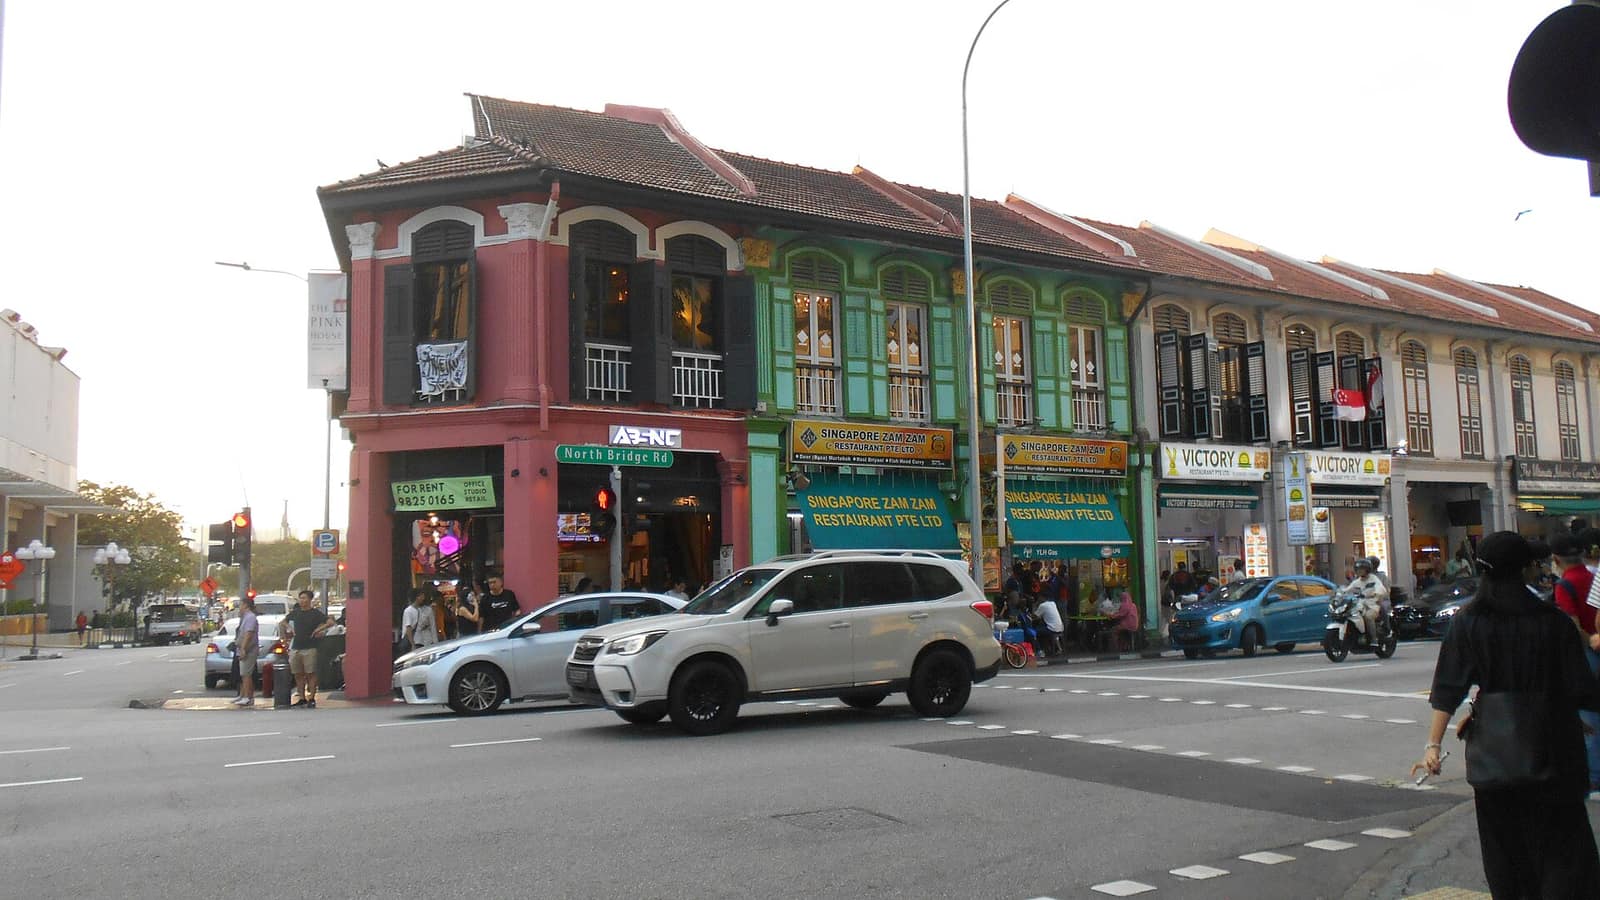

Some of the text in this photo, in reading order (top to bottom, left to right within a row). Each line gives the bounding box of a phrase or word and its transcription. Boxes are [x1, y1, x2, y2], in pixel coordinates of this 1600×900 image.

[311, 317, 343, 328] PINK
[821, 428, 879, 442] SINGAPORE
[882, 432, 903, 443] ZAM
[905, 433, 926, 443] ZAM
[834, 442, 915, 454] RESTAURANT PTE LTD
[1020, 441, 1068, 453] SINGAPORE
[1070, 444, 1088, 454] ZAM
[1089, 445, 1106, 455] ZAM
[564, 447, 668, 465] North Bridge Rd
[1031, 454, 1072, 463] RESTAURANT
[1182, 449, 1235, 468] VICTORY
[1316, 456, 1361, 474] VICTORY
[396, 482, 445, 495] FOR RENT
[398, 494, 455, 507] 9825 0165
[807, 495, 937, 510] SINGAPORE ZAM ZAM
[1005, 491, 1109, 505] SINGAPORE ZAM ZAM
[813, 513, 943, 527] RESTAURANT PTE LTD
[1010, 508, 1114, 521] RESTAURANT PTE LTD
